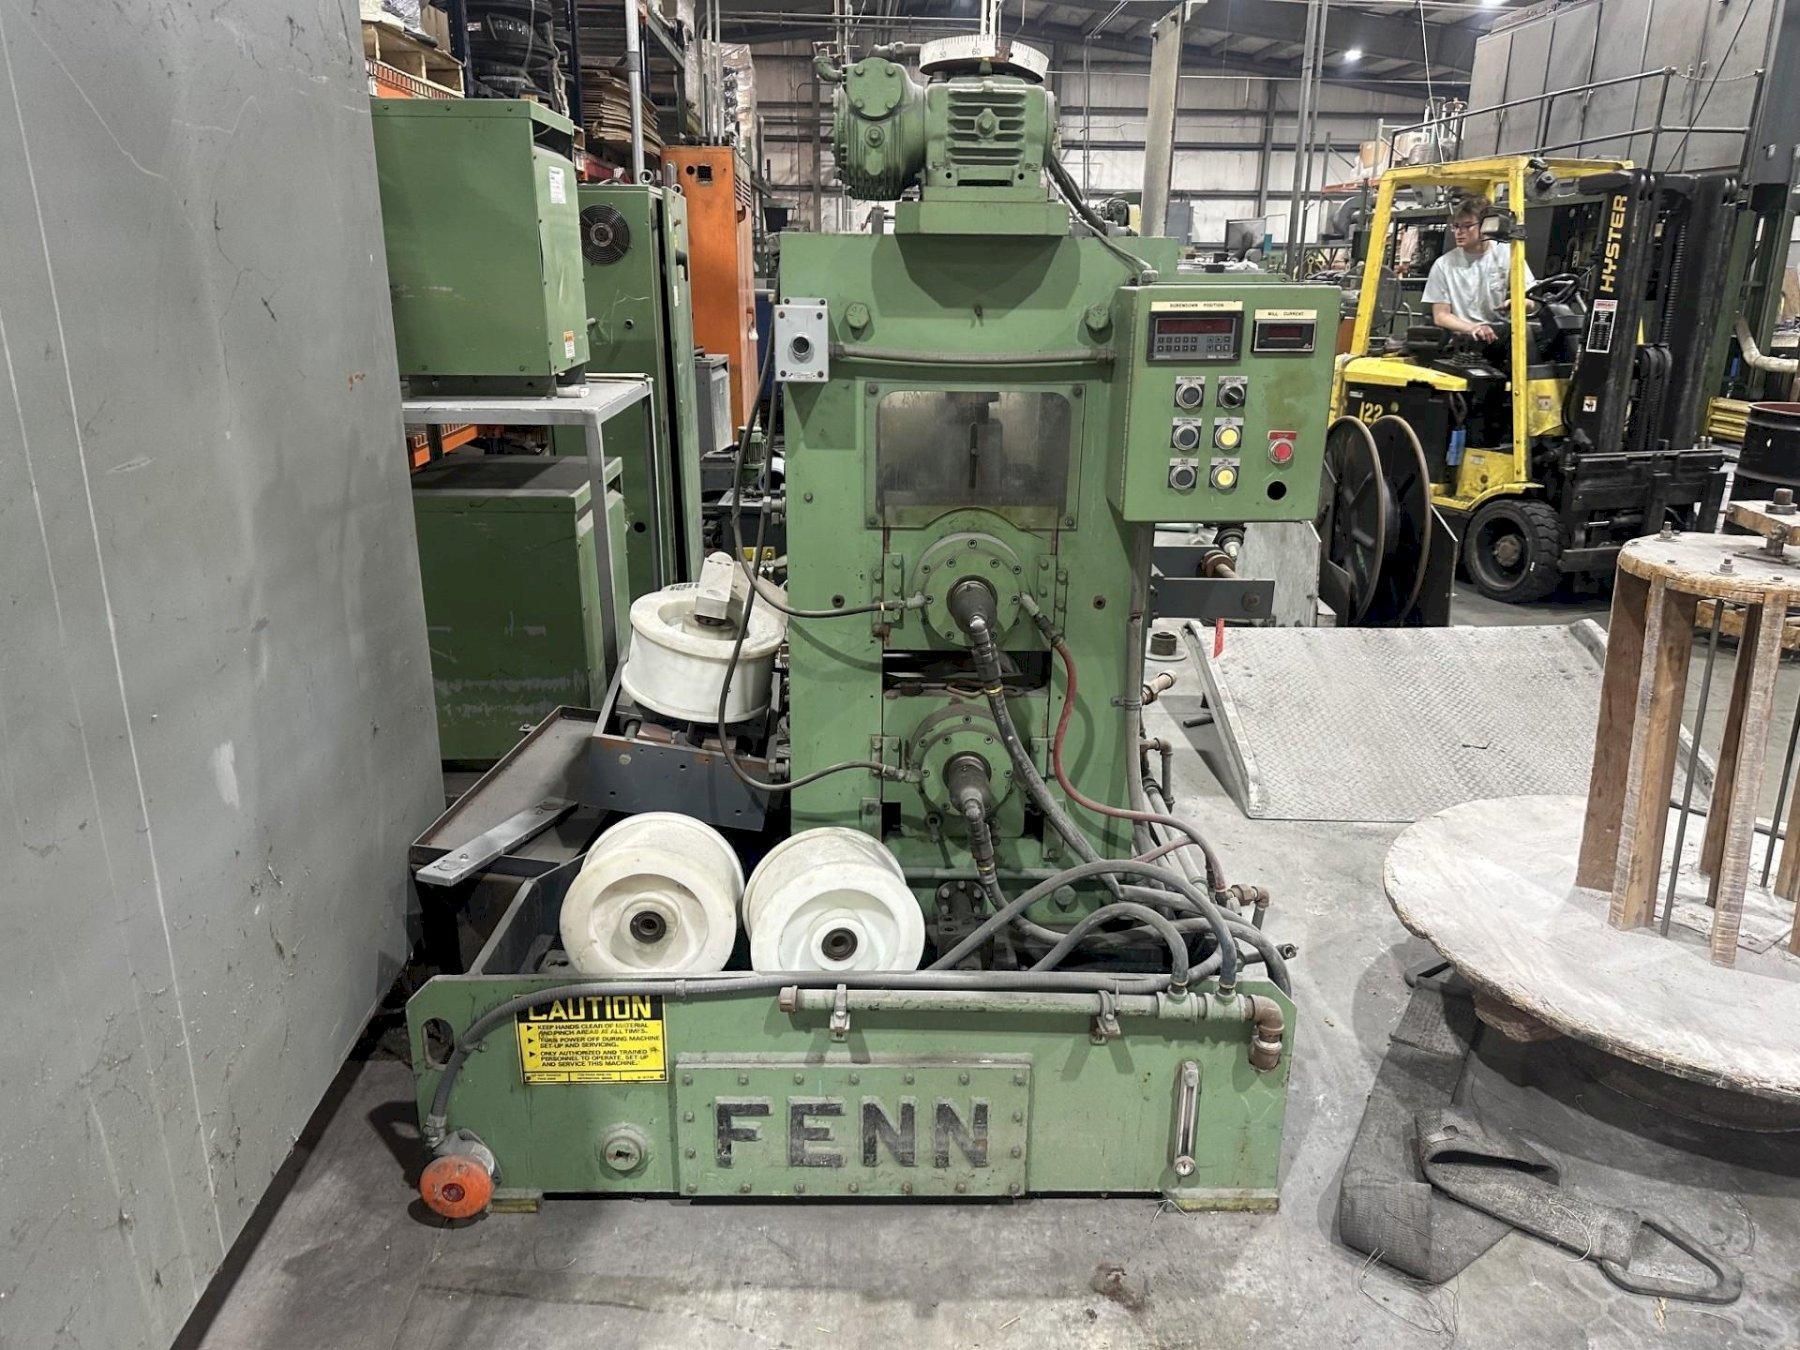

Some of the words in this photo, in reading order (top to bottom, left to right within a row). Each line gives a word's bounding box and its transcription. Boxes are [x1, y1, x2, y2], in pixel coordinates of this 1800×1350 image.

[1600, 194, 1628, 293] HYSTER
[1359, 401, 1383, 423] 122
[529, 995, 651, 1020] CAUTION
[715, 1096, 990, 1168] FENN
